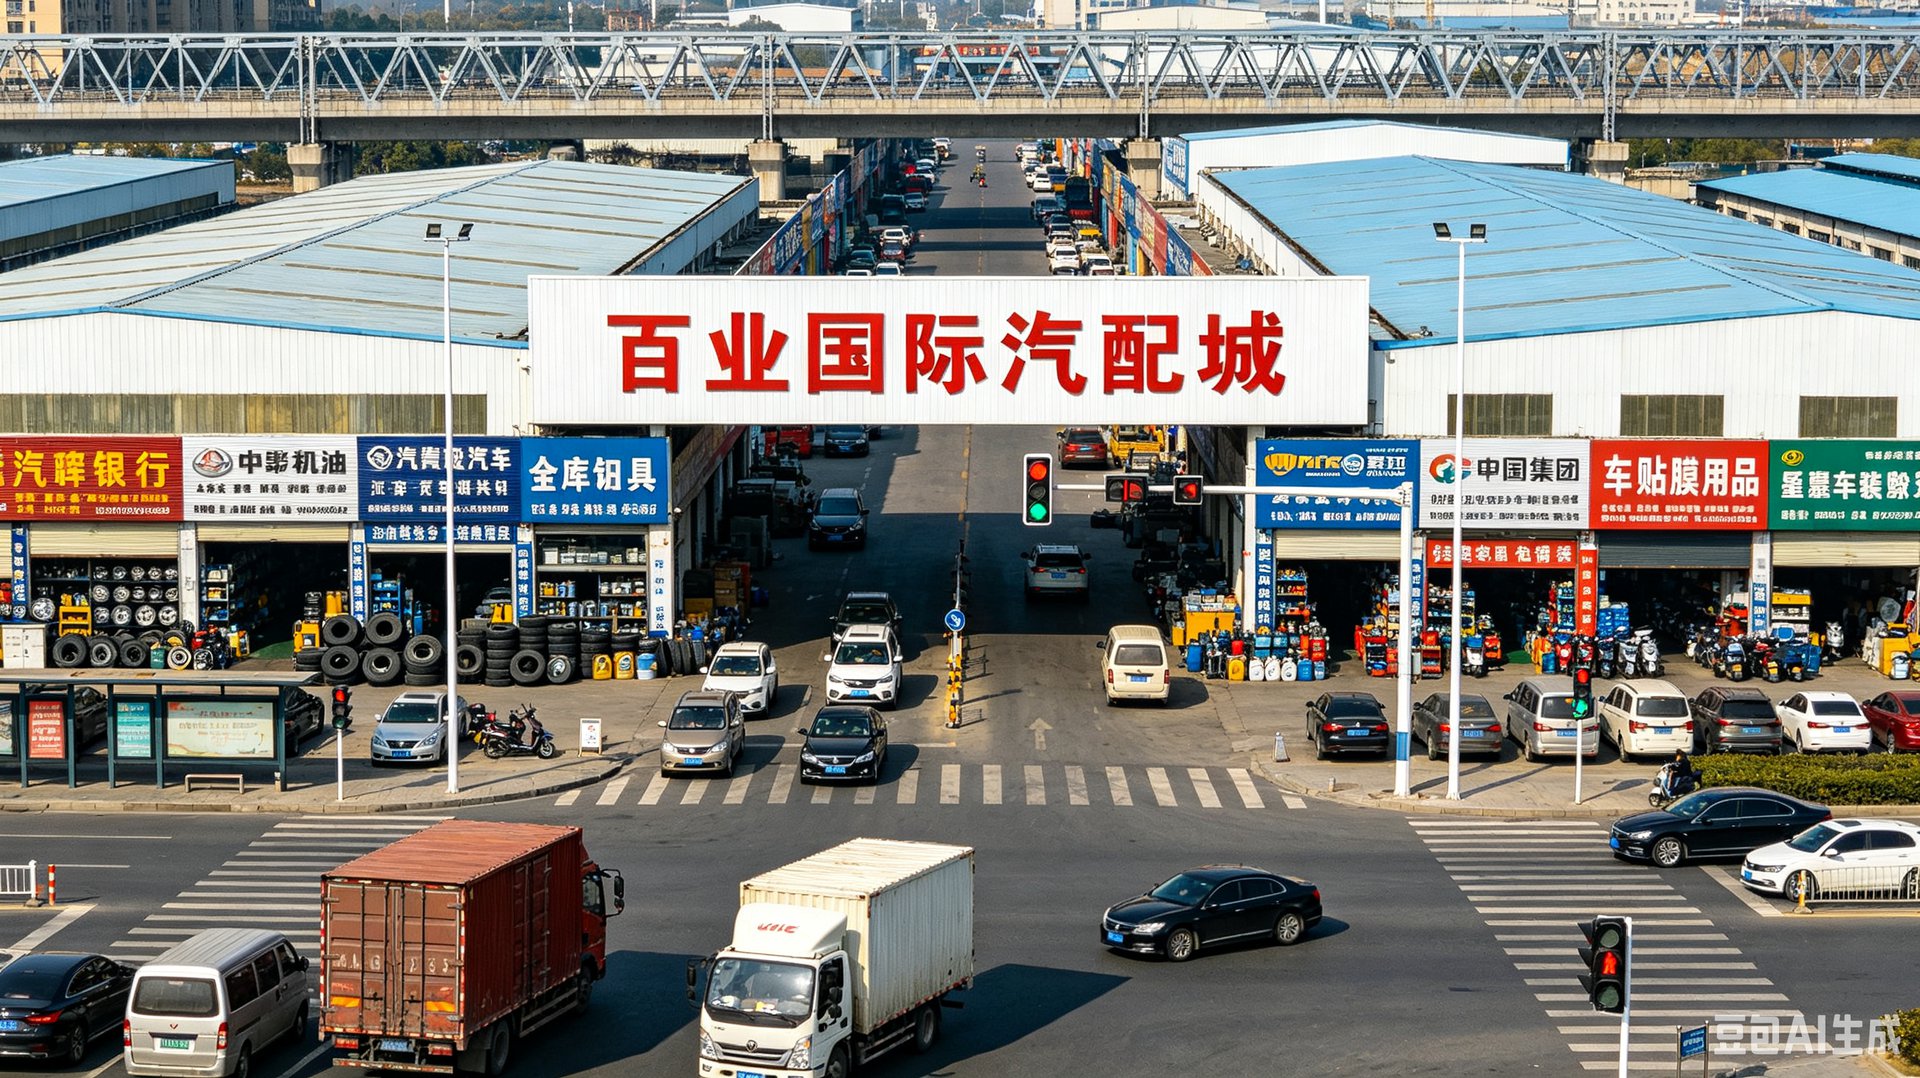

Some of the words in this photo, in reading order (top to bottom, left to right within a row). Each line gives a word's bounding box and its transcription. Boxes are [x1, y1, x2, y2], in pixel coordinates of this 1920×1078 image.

[607, 310, 1287, 395] 百业国际汽配城
[1603, 454, 1760, 498] 车贴膜用品
